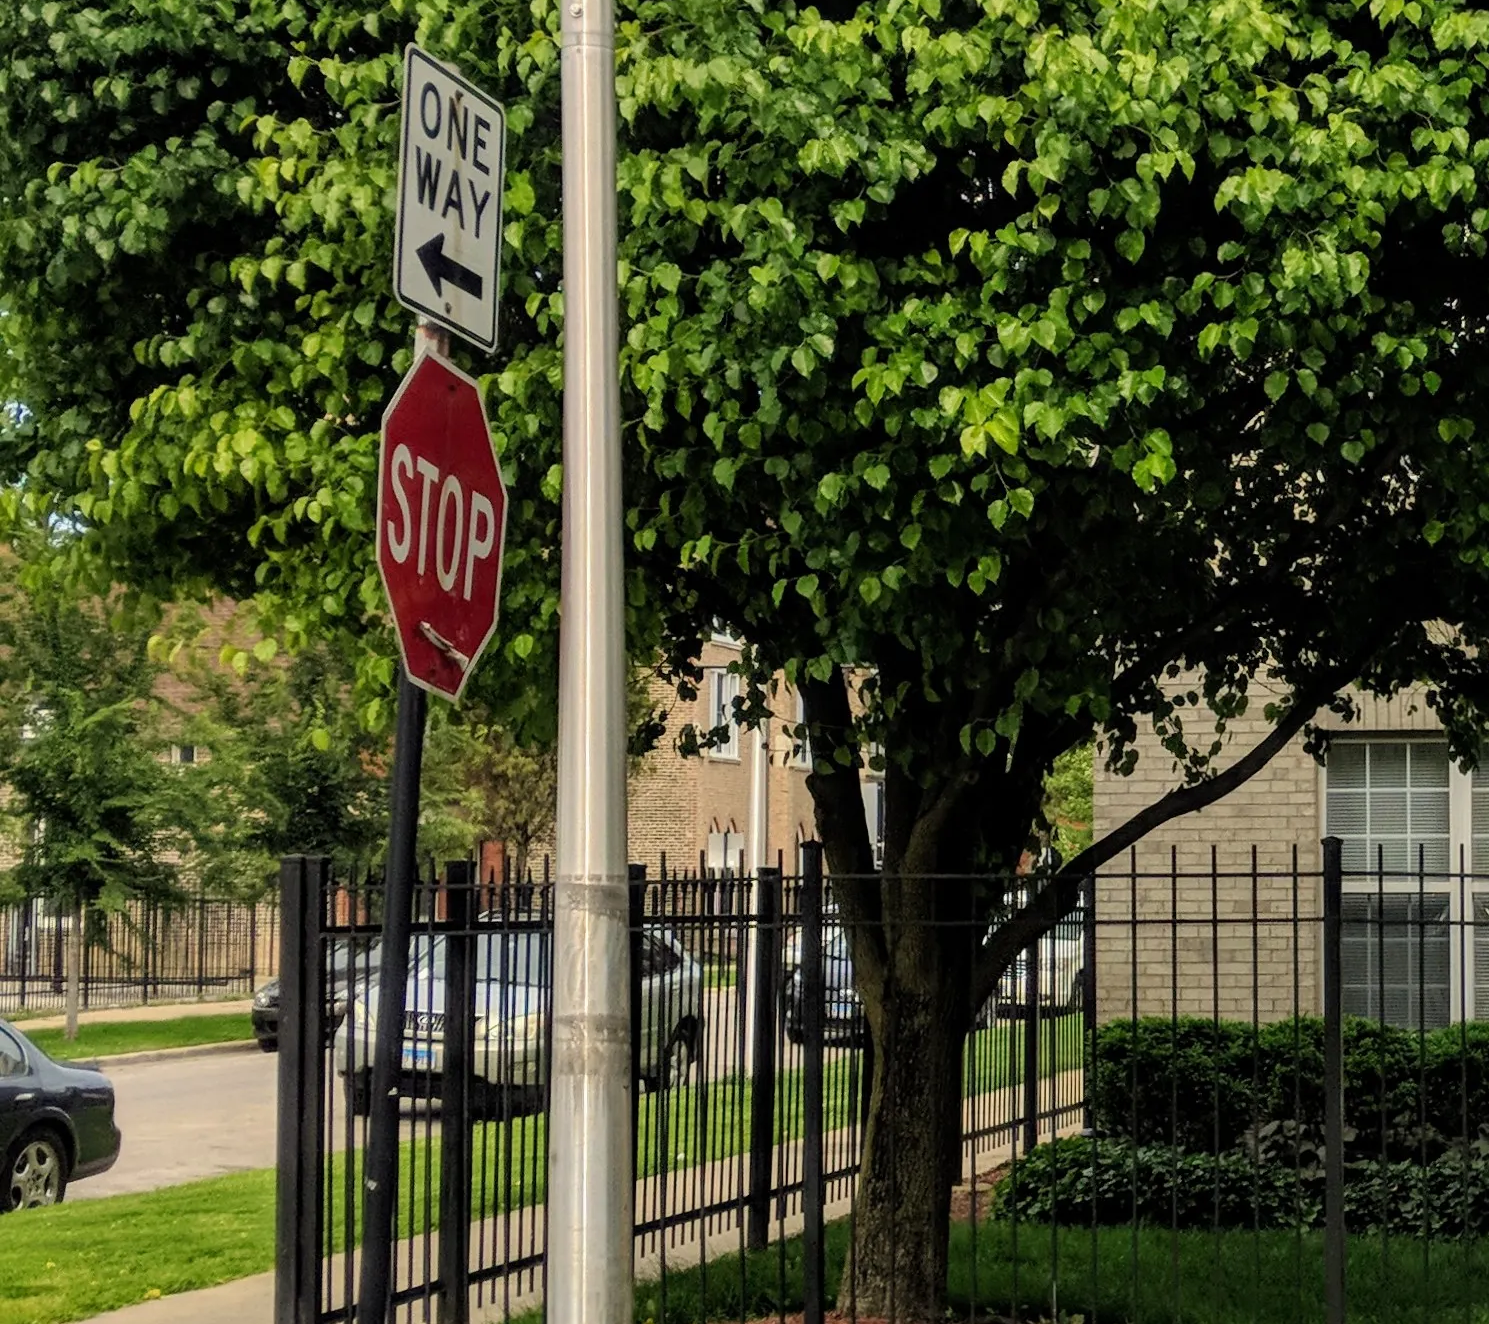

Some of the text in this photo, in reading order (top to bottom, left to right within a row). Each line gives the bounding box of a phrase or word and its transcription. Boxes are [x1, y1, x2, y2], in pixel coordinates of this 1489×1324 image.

[420, 81, 491, 176] ONE
[416, 145, 491, 239] WAY
[387, 443, 494, 601] STOP
